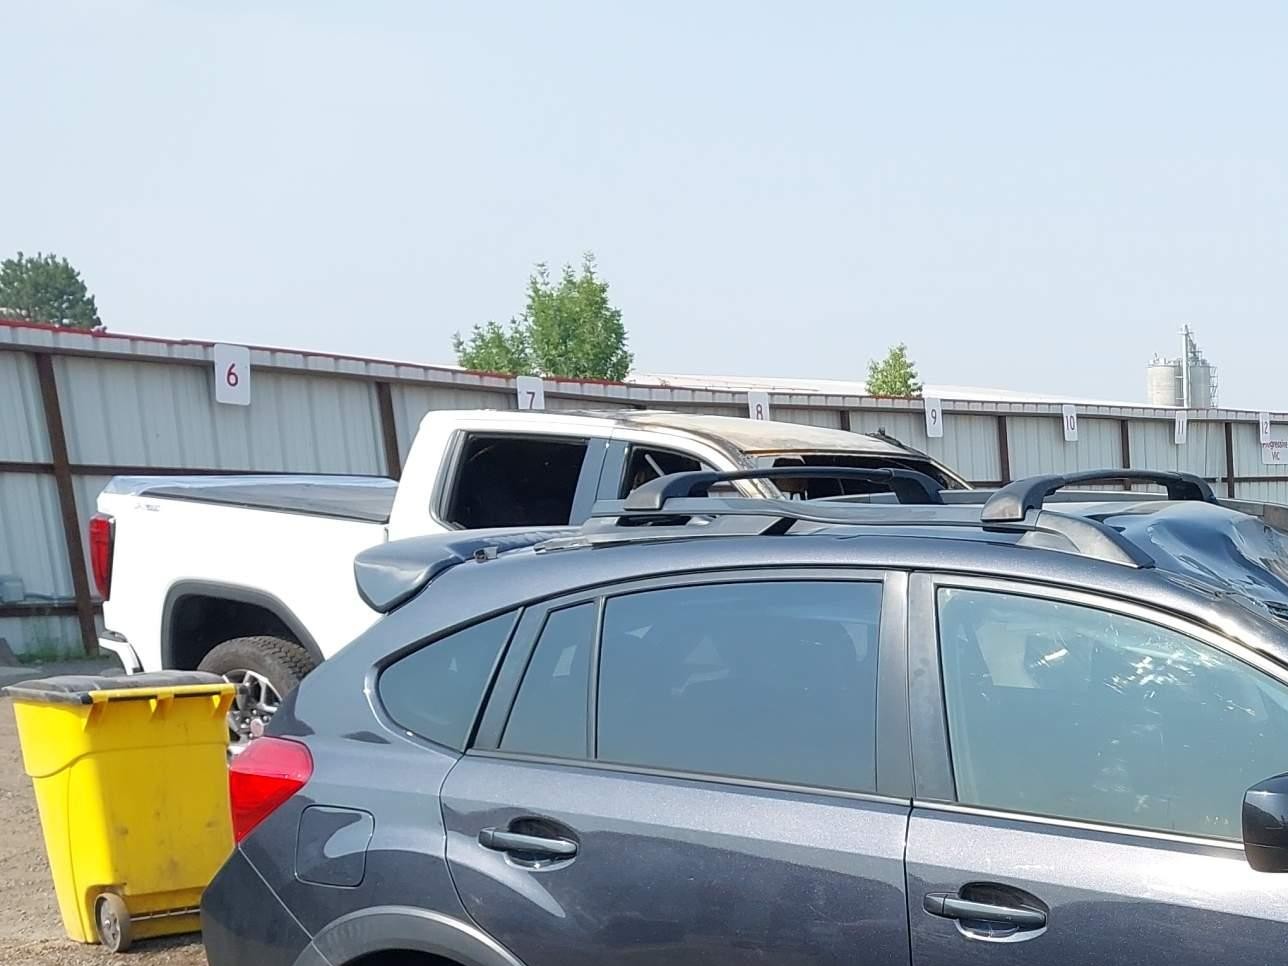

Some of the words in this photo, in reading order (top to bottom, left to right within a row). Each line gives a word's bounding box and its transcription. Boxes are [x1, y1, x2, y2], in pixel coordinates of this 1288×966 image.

[226, 362, 239, 388] 6
[526, 391, 536, 410] 7
[930, 408, 937, 425] 9
[1065, 415, 1075, 431] 10
